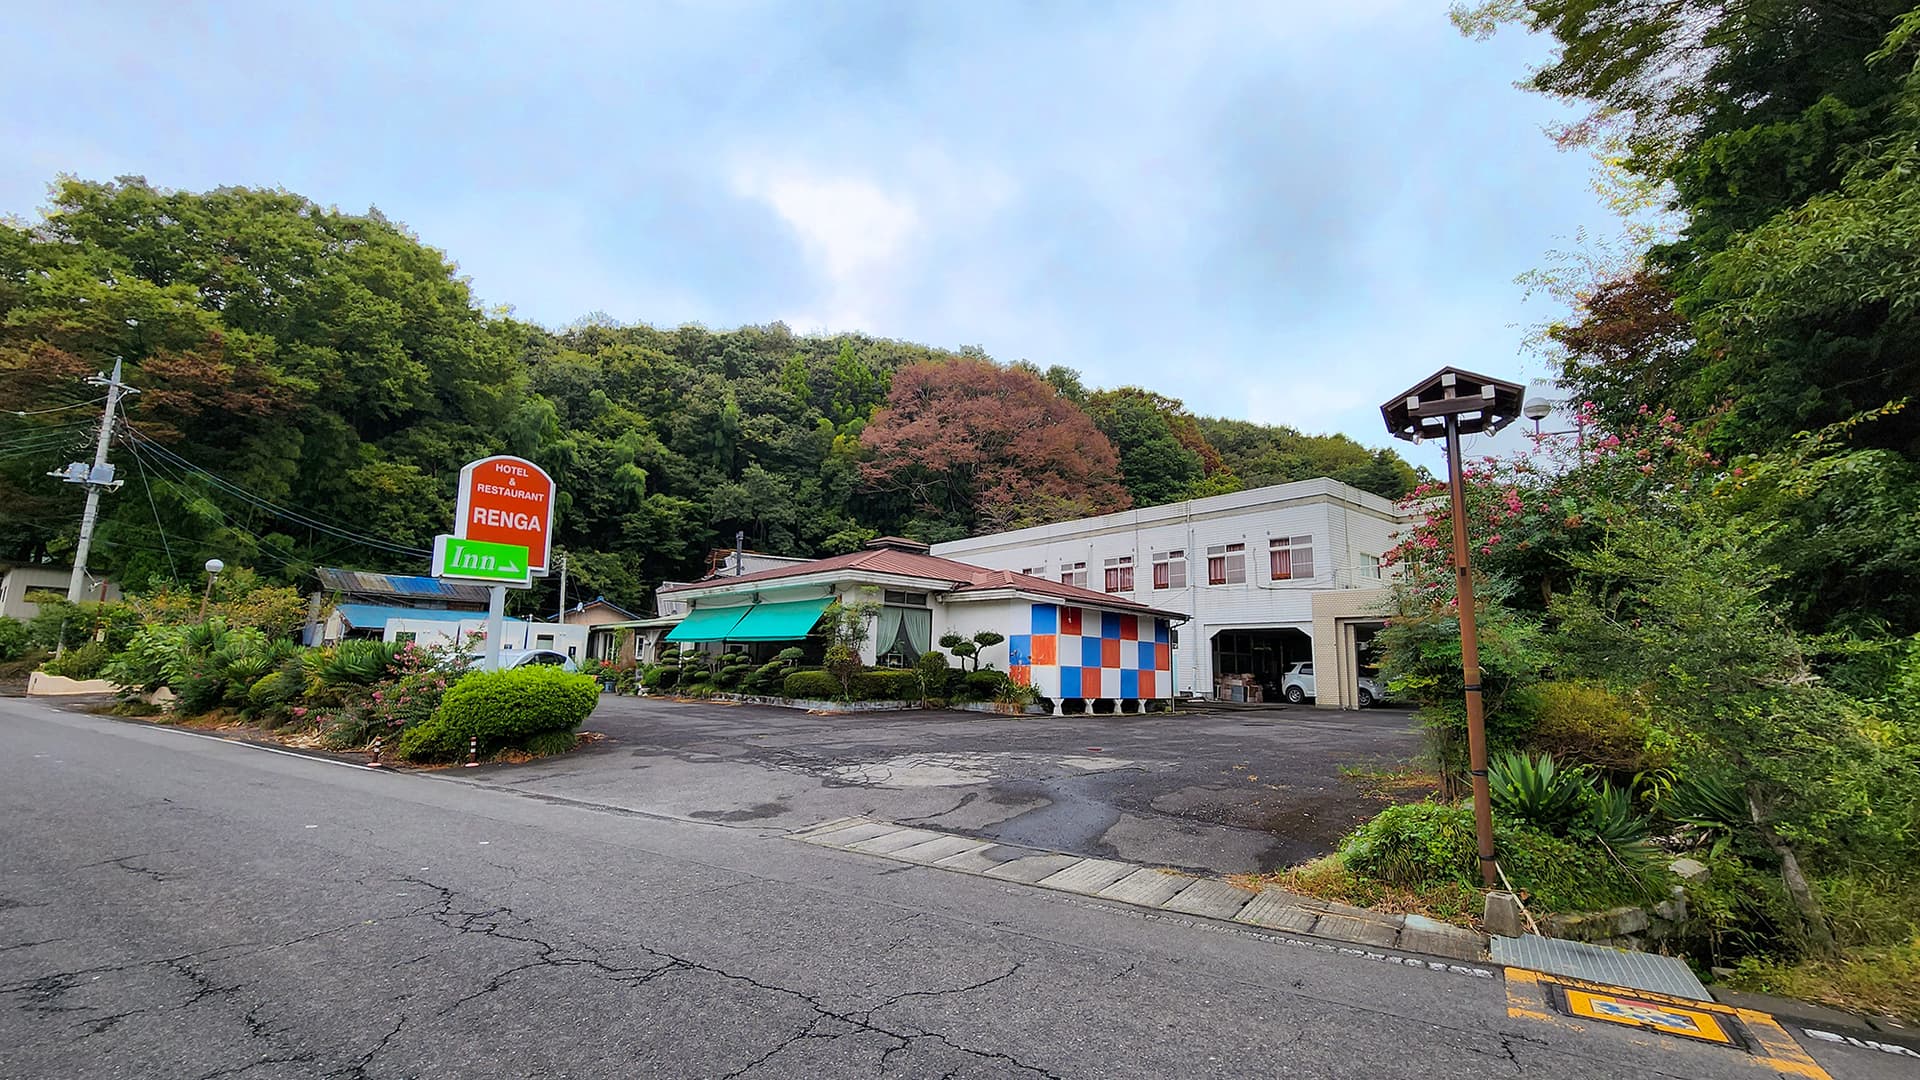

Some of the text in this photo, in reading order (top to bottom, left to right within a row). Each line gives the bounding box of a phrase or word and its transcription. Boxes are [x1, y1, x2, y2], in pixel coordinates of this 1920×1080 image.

[496, 464, 528, 477] HOTEL
[508, 478, 516, 486] &
[477, 483, 545, 502] RESTAURANT
[473, 507, 542, 532] RENGA
[450, 545, 497, 571] Inn
